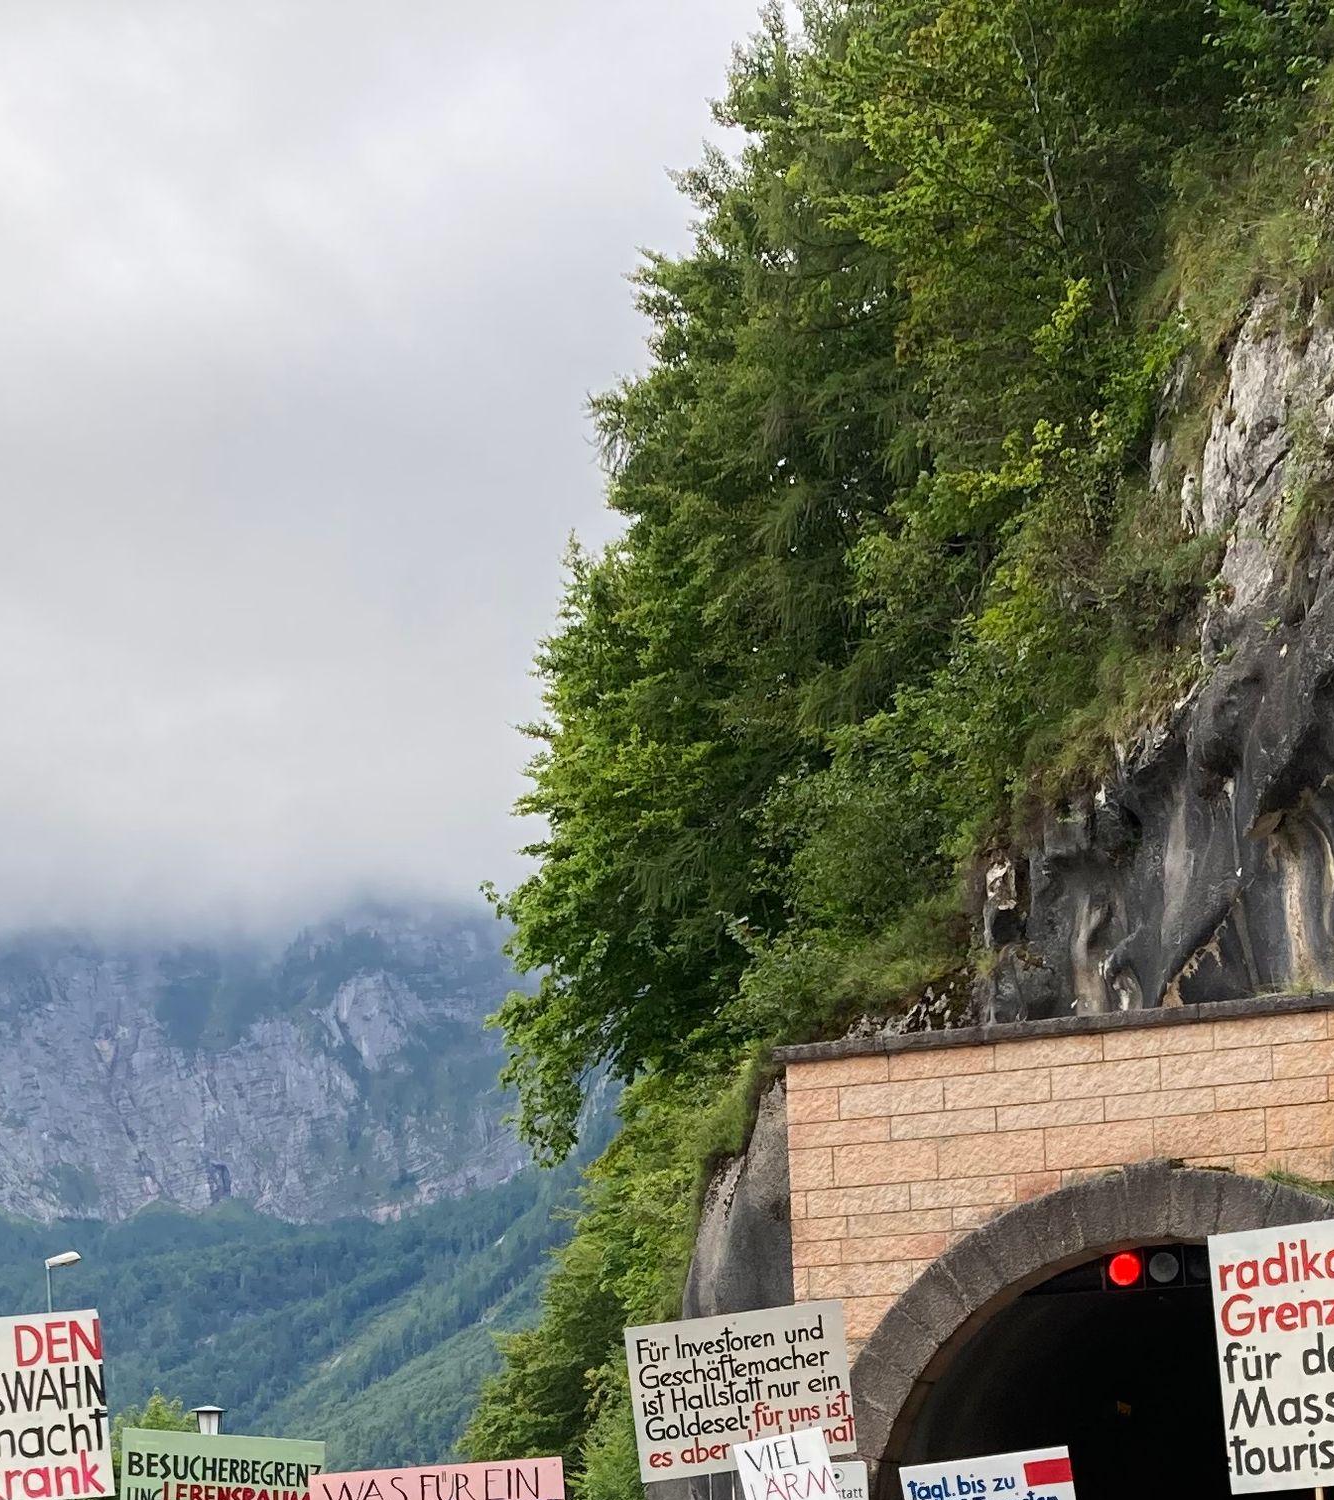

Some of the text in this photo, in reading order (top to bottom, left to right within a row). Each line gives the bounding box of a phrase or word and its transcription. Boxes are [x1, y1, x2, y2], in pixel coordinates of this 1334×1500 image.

[13, 1319, 102, 1366] DEN
[636, 1314, 824, 1364] Für Investoren und
[639, 1344, 830, 1389] Geschäftemacher
[1224, 1342, 1282, 1384] für
[640, 1369, 841, 1417] ist Hallstatt nur ein
[752, 1402, 784, 1432] für
[788, 1404, 820, 1422] uns
[825, 1390, 850, 1419] ist
[649, 1451, 673, 1468] es
[680, 1436, 731, 1464] aber
[744, 1435, 810, 1472] VIEL
[484, 1467, 539, 1500] EIN
[957, 1473, 987, 1496] bis
[993, 1476, 1015, 1492] zu
